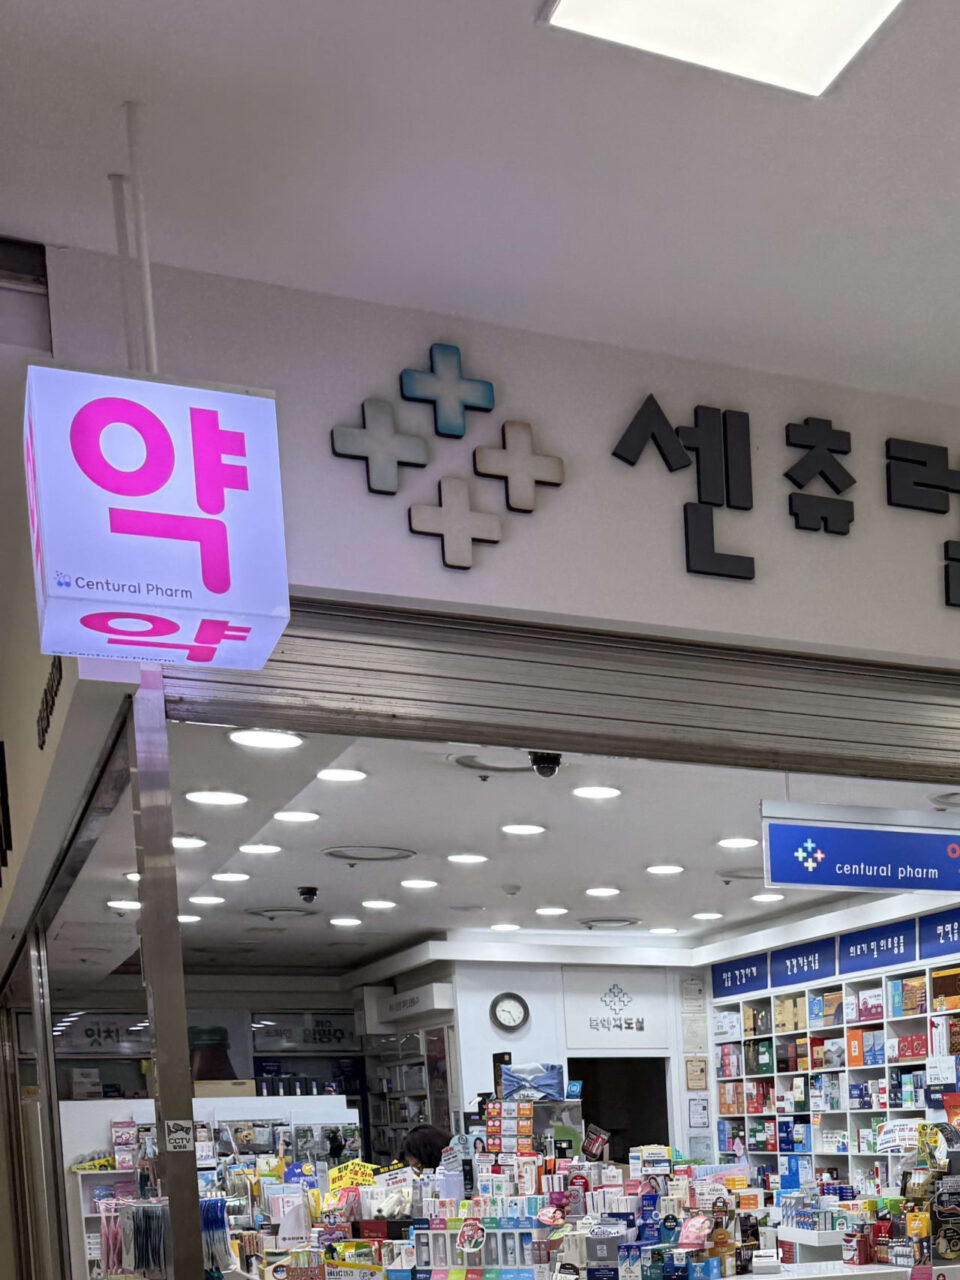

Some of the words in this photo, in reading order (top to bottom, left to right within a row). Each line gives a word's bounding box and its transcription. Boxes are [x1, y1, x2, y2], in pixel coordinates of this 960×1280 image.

[69, 397, 249, 594] 약
[75, 576, 142, 595] Centural
[146, 583, 193, 599] Pharm
[79, 611, 252, 662] 약
[835, 862, 892, 876] centural
[898, 864, 939, 879] pharm
[936, 921, 959, 944] 면역을
